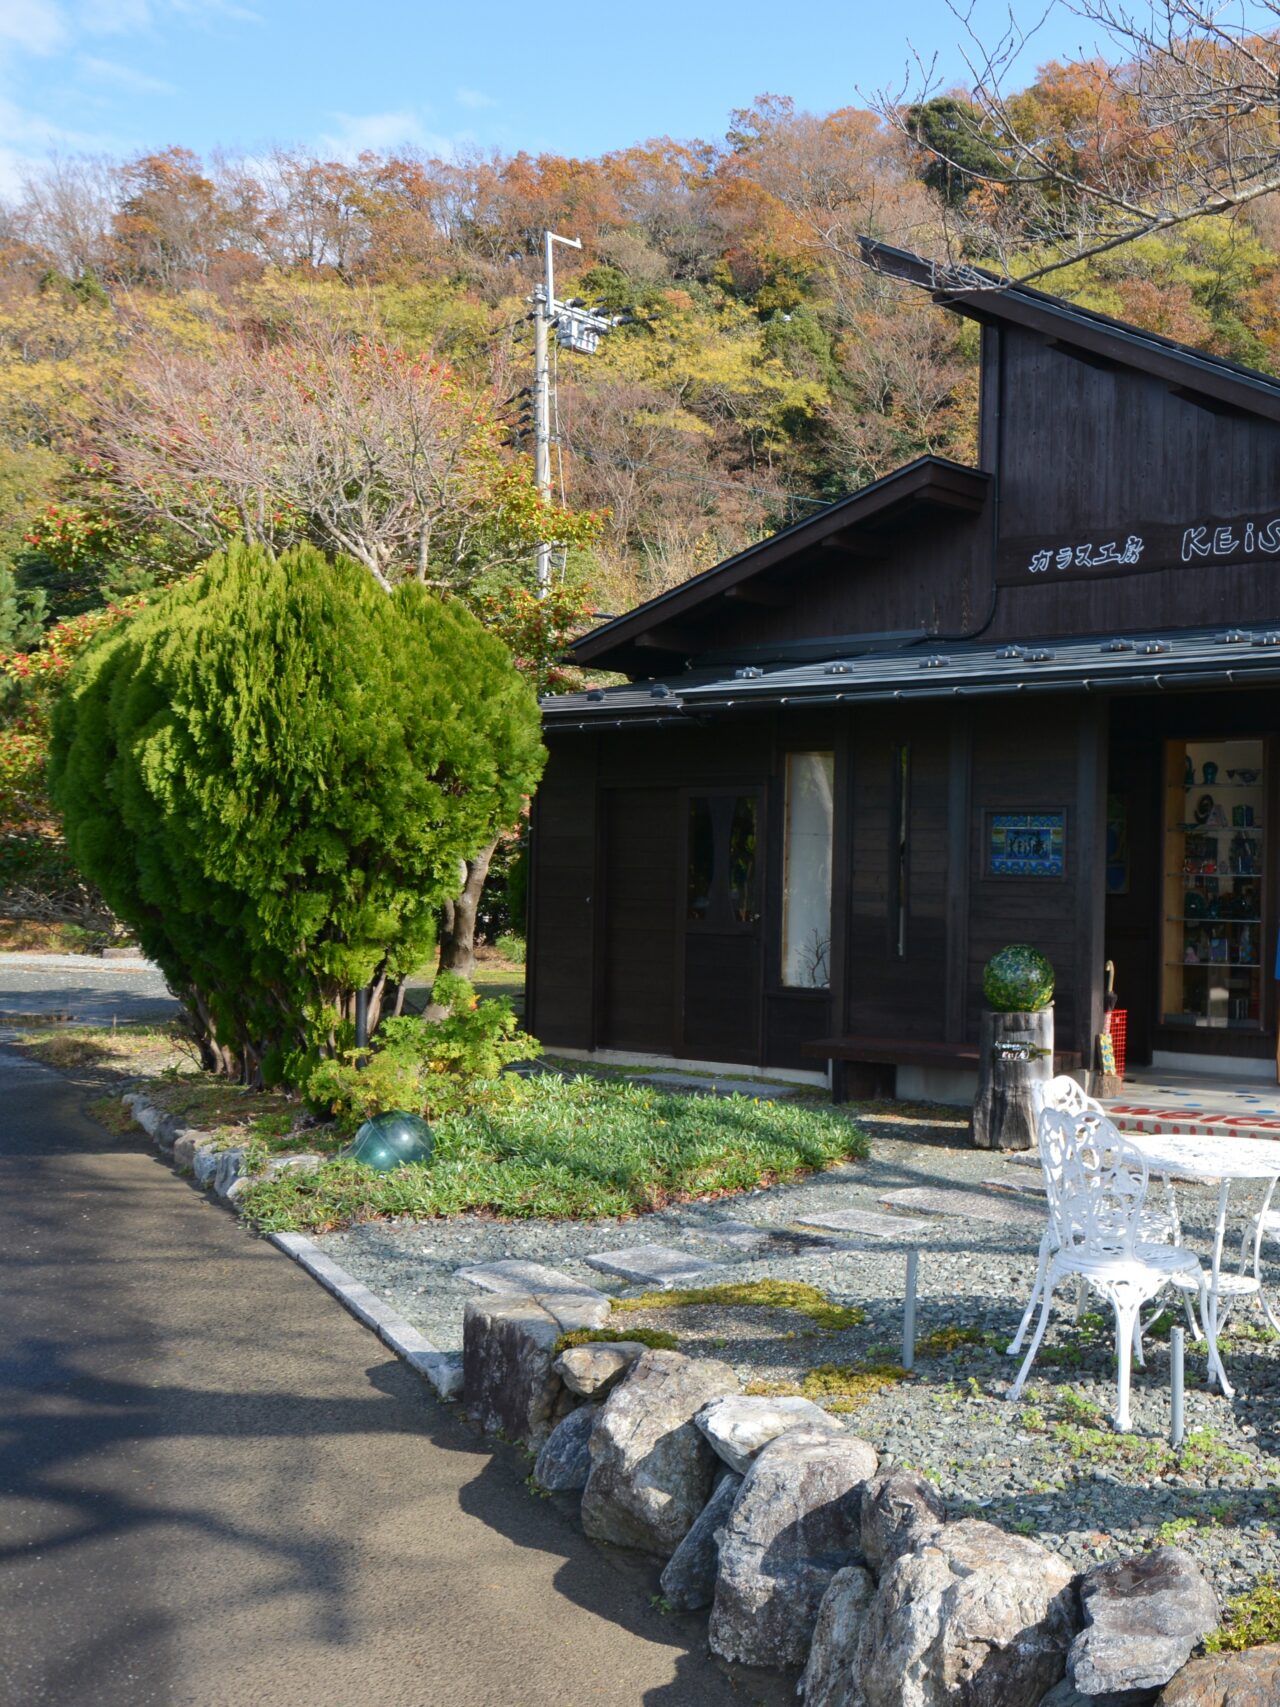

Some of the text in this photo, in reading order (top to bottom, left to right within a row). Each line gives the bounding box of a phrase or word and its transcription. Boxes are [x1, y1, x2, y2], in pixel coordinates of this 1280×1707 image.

[1029, 536, 1145, 573] ガラス工房
